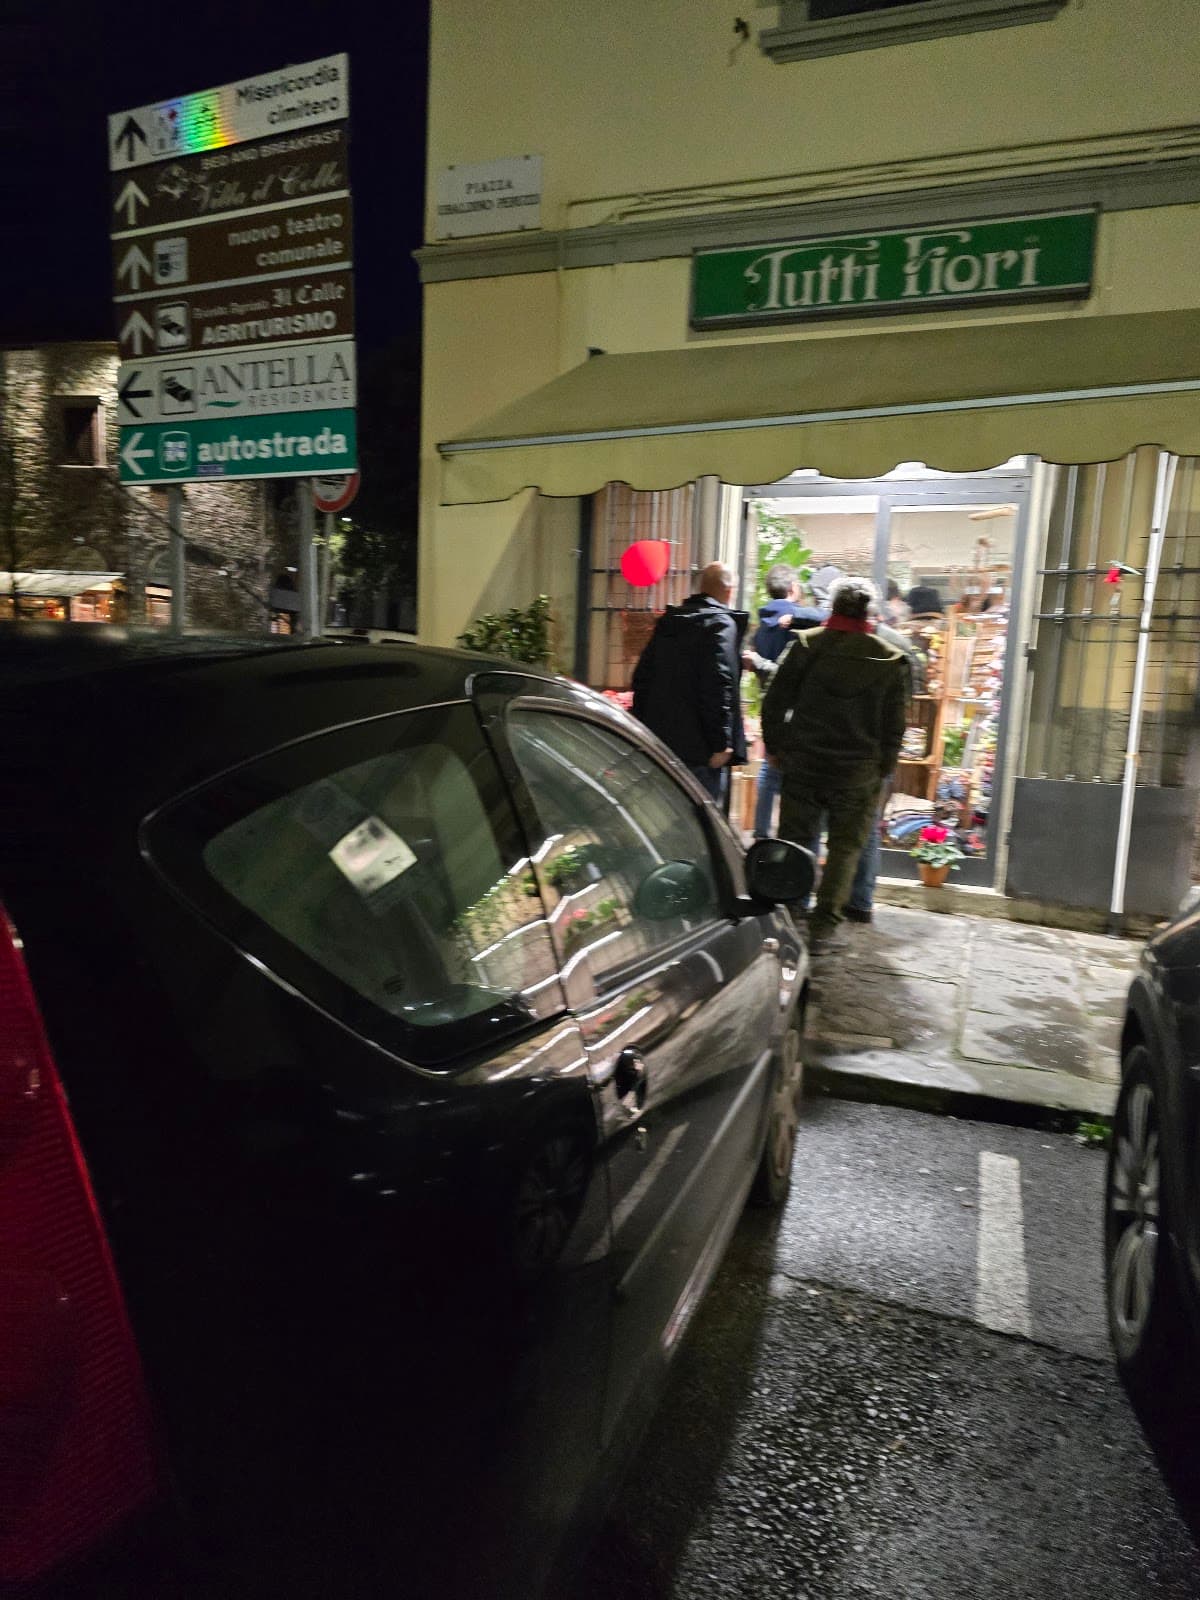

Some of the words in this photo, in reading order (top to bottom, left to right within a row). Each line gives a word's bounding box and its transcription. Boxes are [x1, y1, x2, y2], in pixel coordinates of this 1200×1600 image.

[237, 65, 340, 102] Misericordia
[267, 97, 340, 124] cimitero
[228, 225, 280, 246] nuovo
[286, 212, 344, 235] teatro
[256, 238, 344, 267] comunale
[743, 238, 881, 312] Tutti
[901, 230, 1041, 298] Fiori
[202, 310, 337, 344] AGRITURISMO
[199, 351, 352, 395] ANTELLA
[249, 386, 349, 409] RESIDENCE
[197, 426, 348, 462] autostrada
